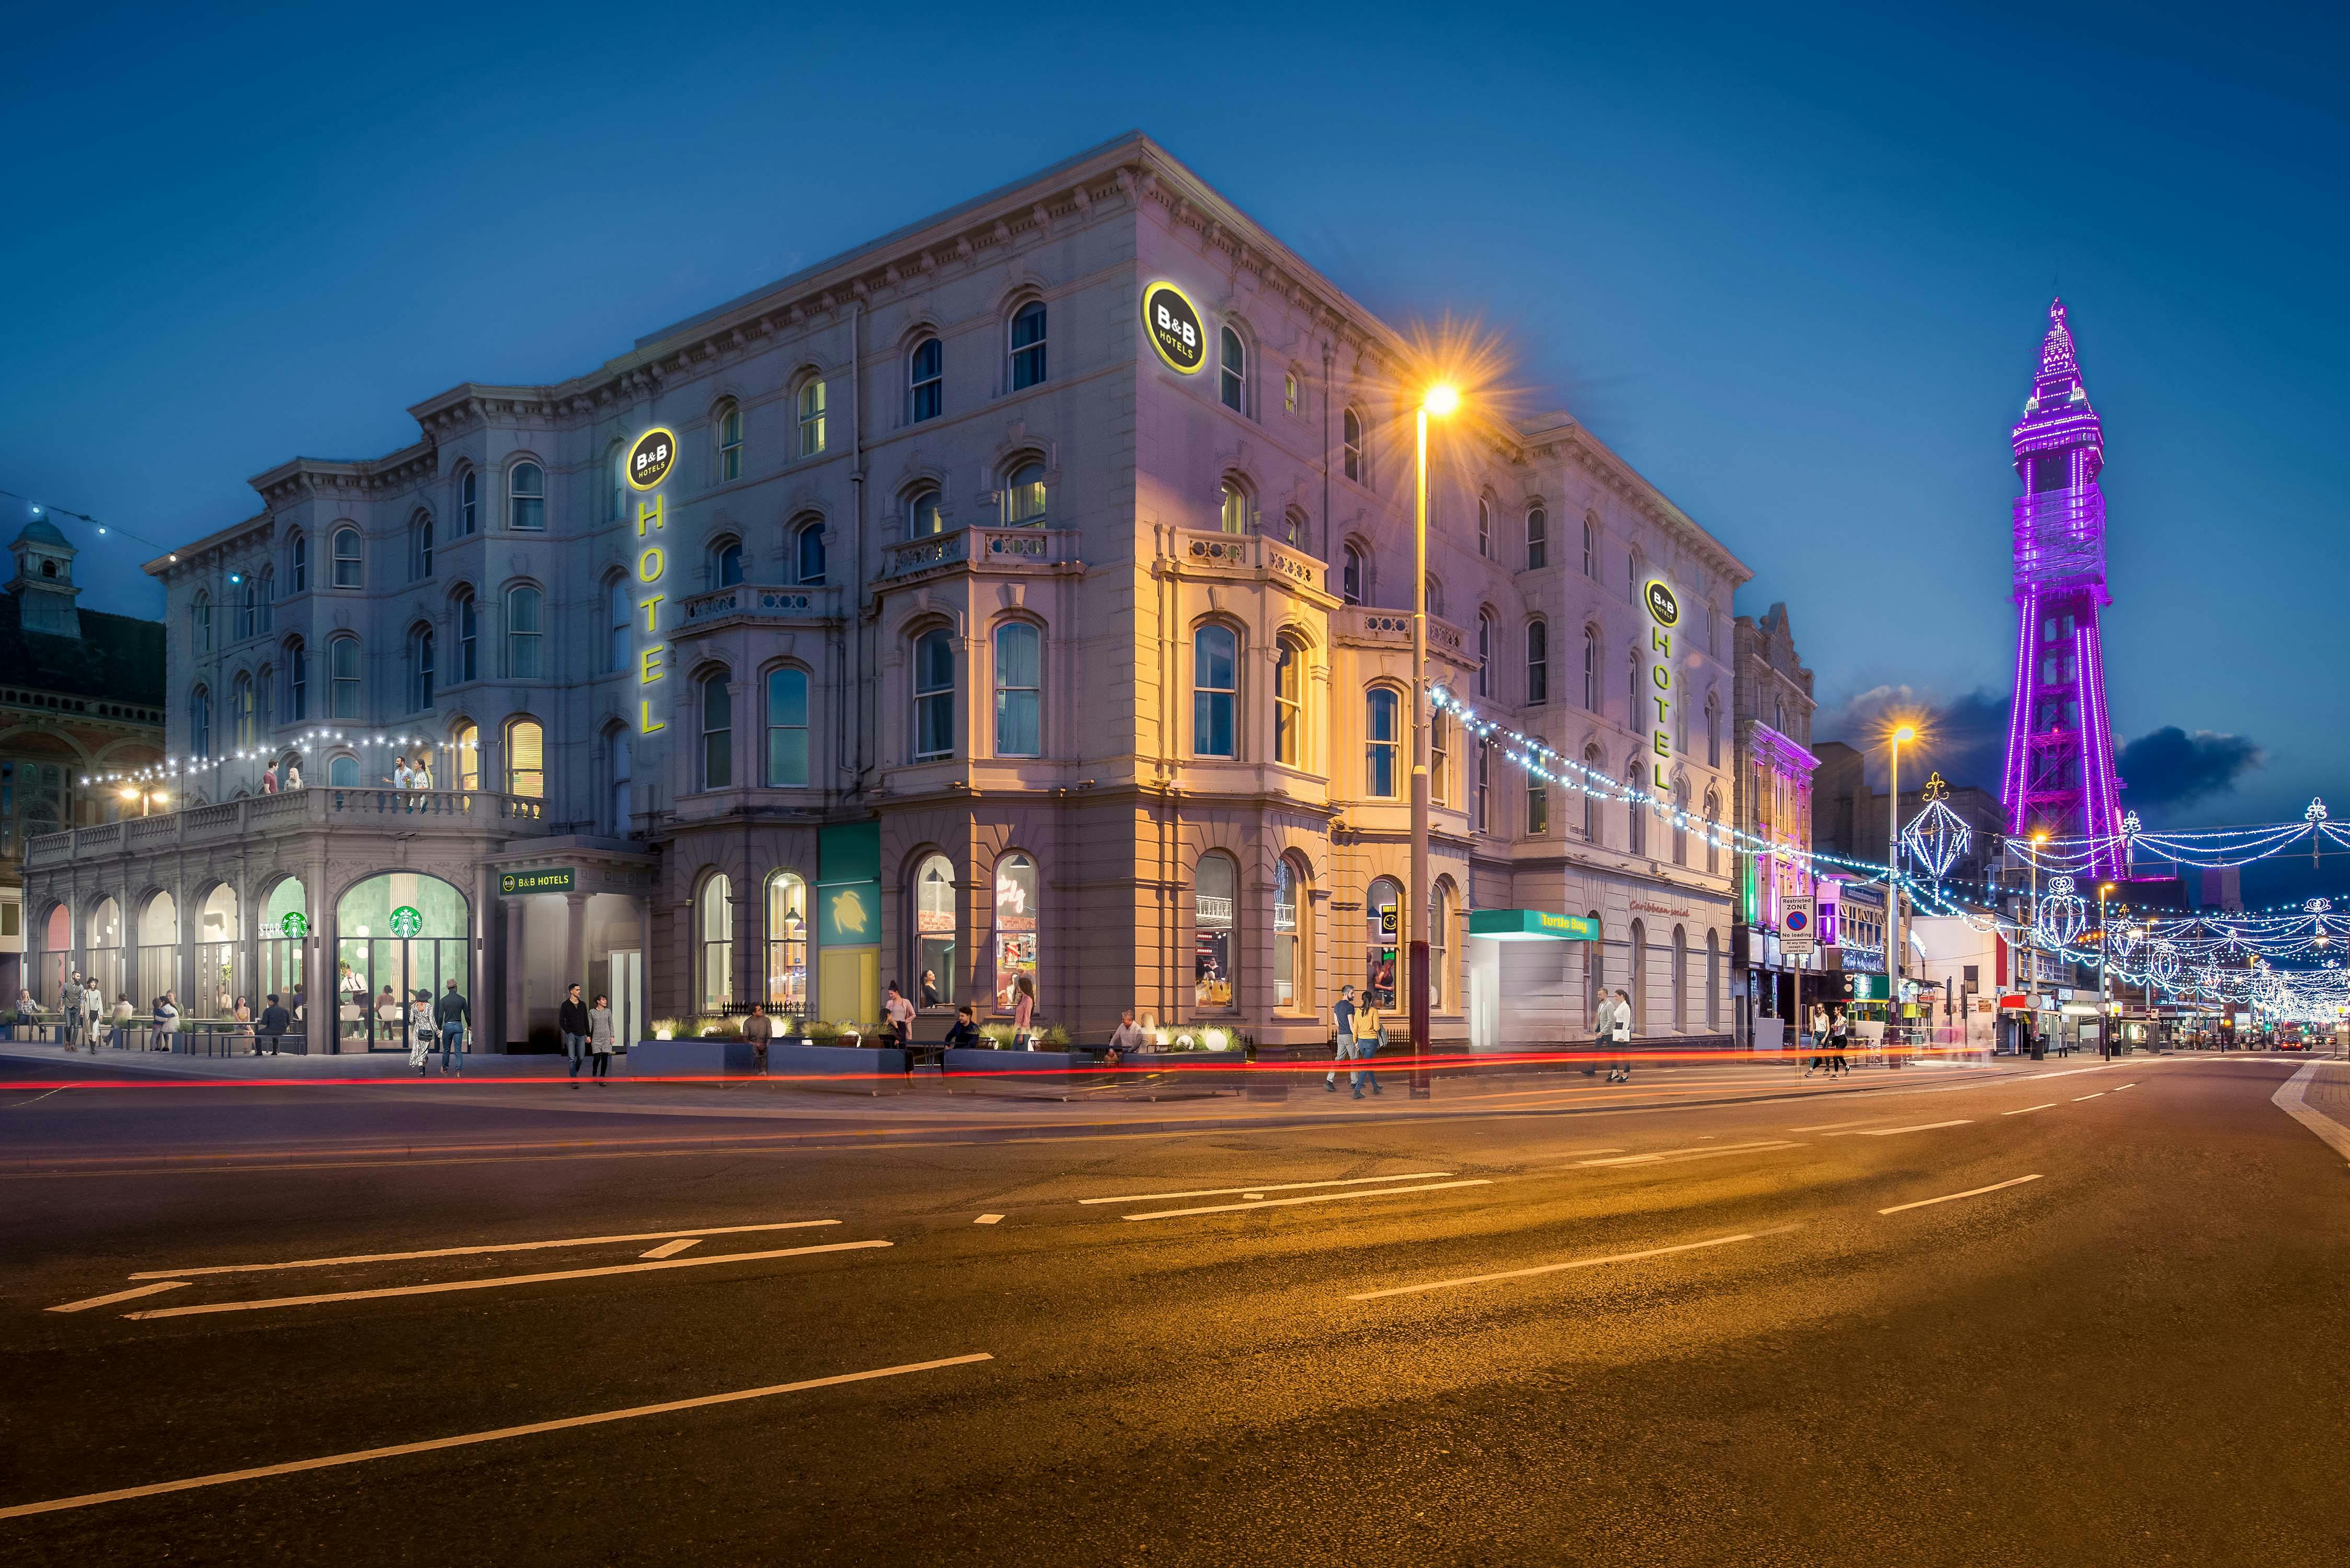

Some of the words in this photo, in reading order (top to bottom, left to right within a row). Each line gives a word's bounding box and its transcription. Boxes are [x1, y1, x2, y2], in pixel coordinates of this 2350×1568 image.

[1157, 303, 1196, 347] B&B
[1160, 330, 1194, 359] HOTELS
[637, 444, 667, 470] B&B
[638, 462, 665, 478] HOTELS
[638, 493, 666, 734] HOTEL
[1654, 591, 1674, 614] B&B
[1655, 604, 1673, 620] HOTELS
[1652, 626, 1671, 791] HOTEL
[519, 878, 535, 886] B&B
[538, 875, 569, 885] HOTELS
[1630, 900, 1670, 914] Caribbean
[1670, 908, 1690, 917] social
[1541, 914, 1569, 928] Turtle
[1571, 918, 1587, 933] Bay
